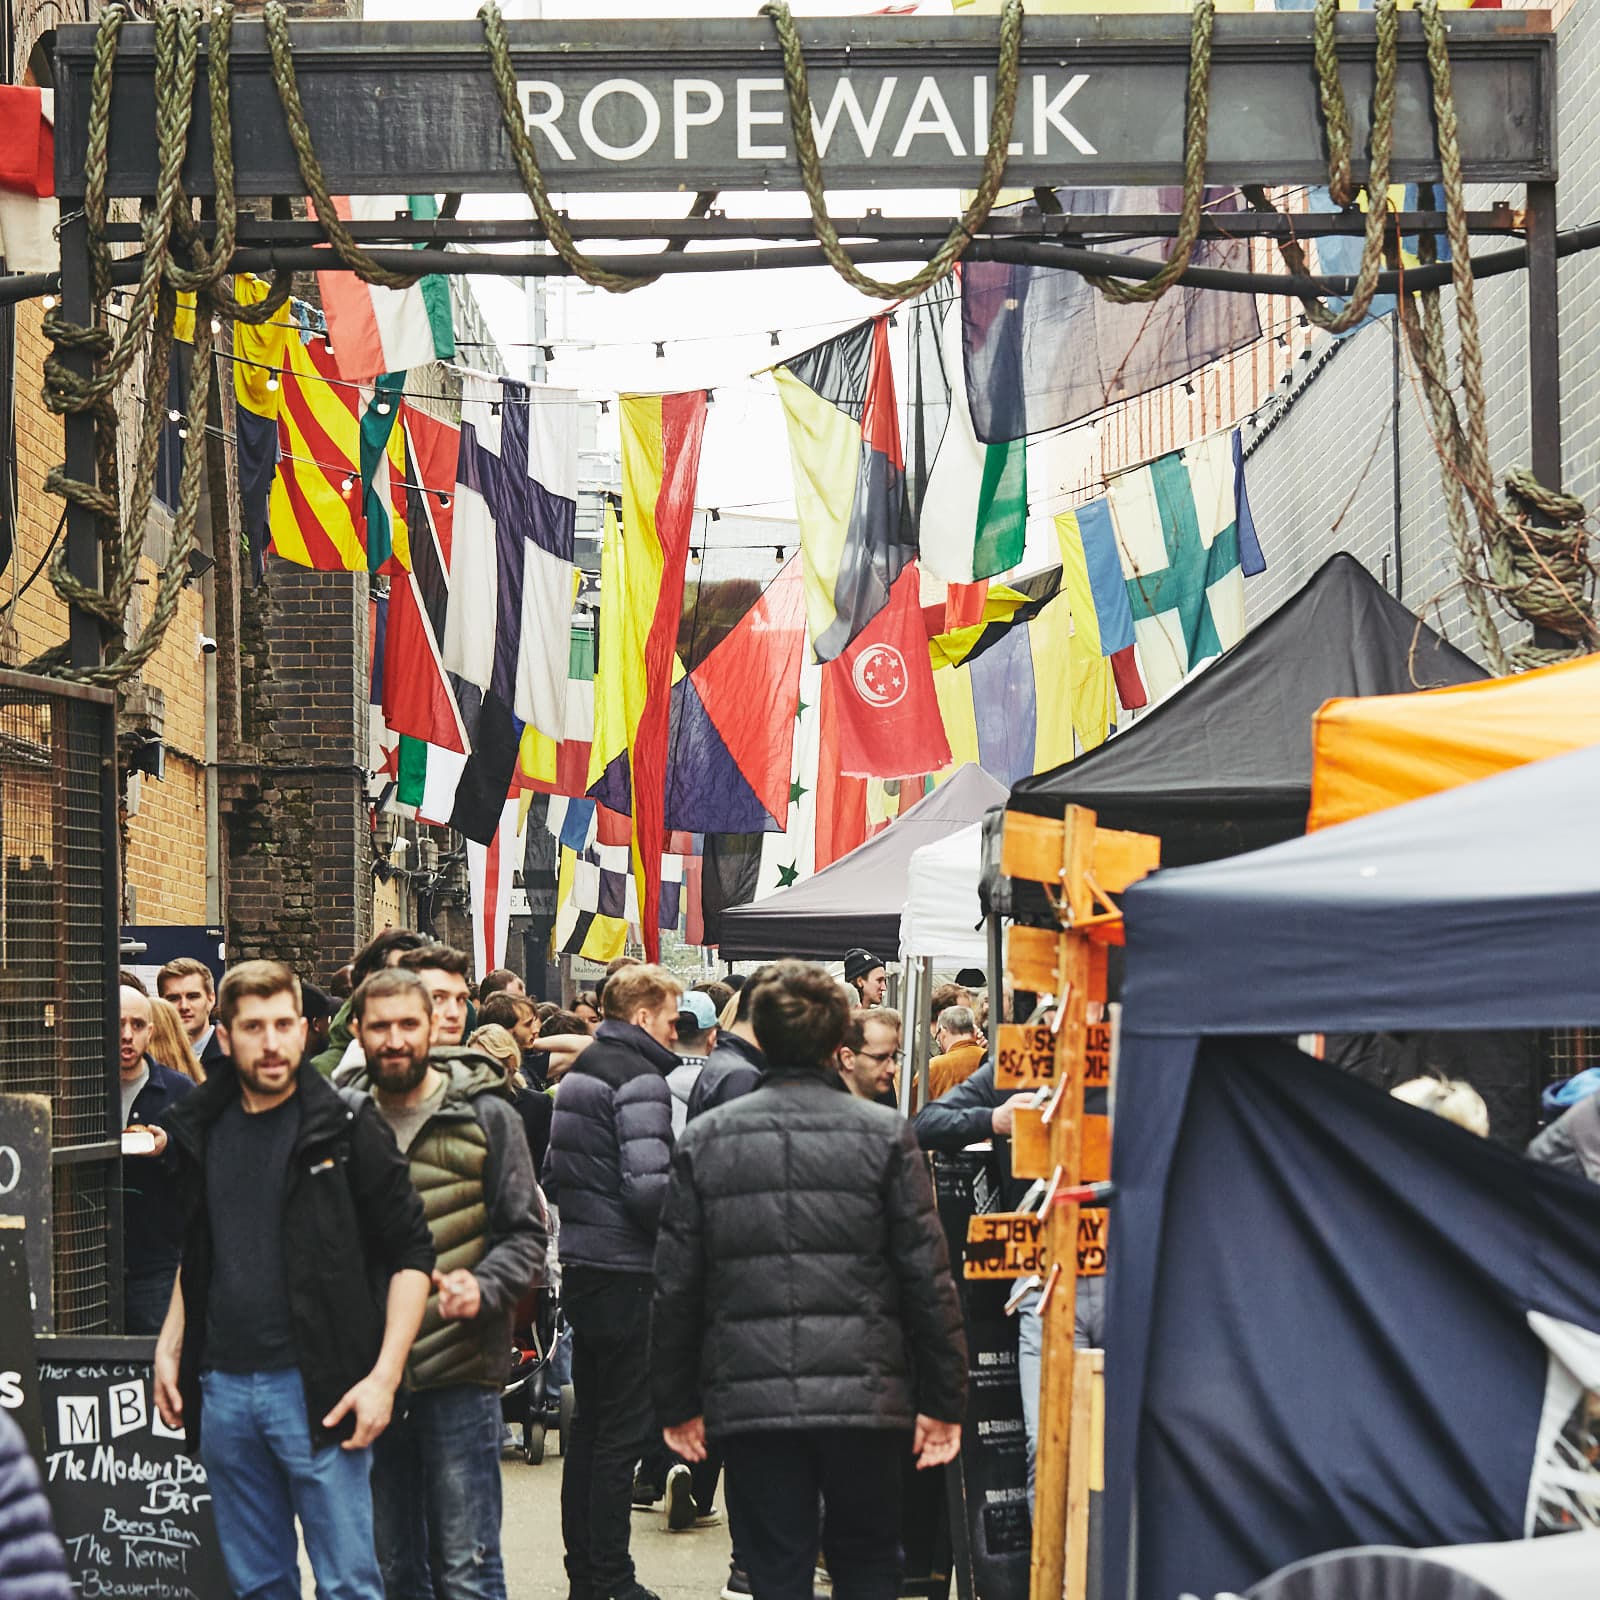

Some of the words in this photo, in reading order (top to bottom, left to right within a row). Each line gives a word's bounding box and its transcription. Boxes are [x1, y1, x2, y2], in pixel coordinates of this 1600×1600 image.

[516, 75, 1098, 160] ROPEWALK
[46, 1450, 87, 1482] The
[91, 1445, 173, 1486] Modern
[140, 1479, 212, 1514] Bar
[103, 1508, 156, 1536] Beers
[160, 1519, 201, 1546] from
[66, 1534, 112, 1567] The
[125, 1540, 187, 1575] Kernel
